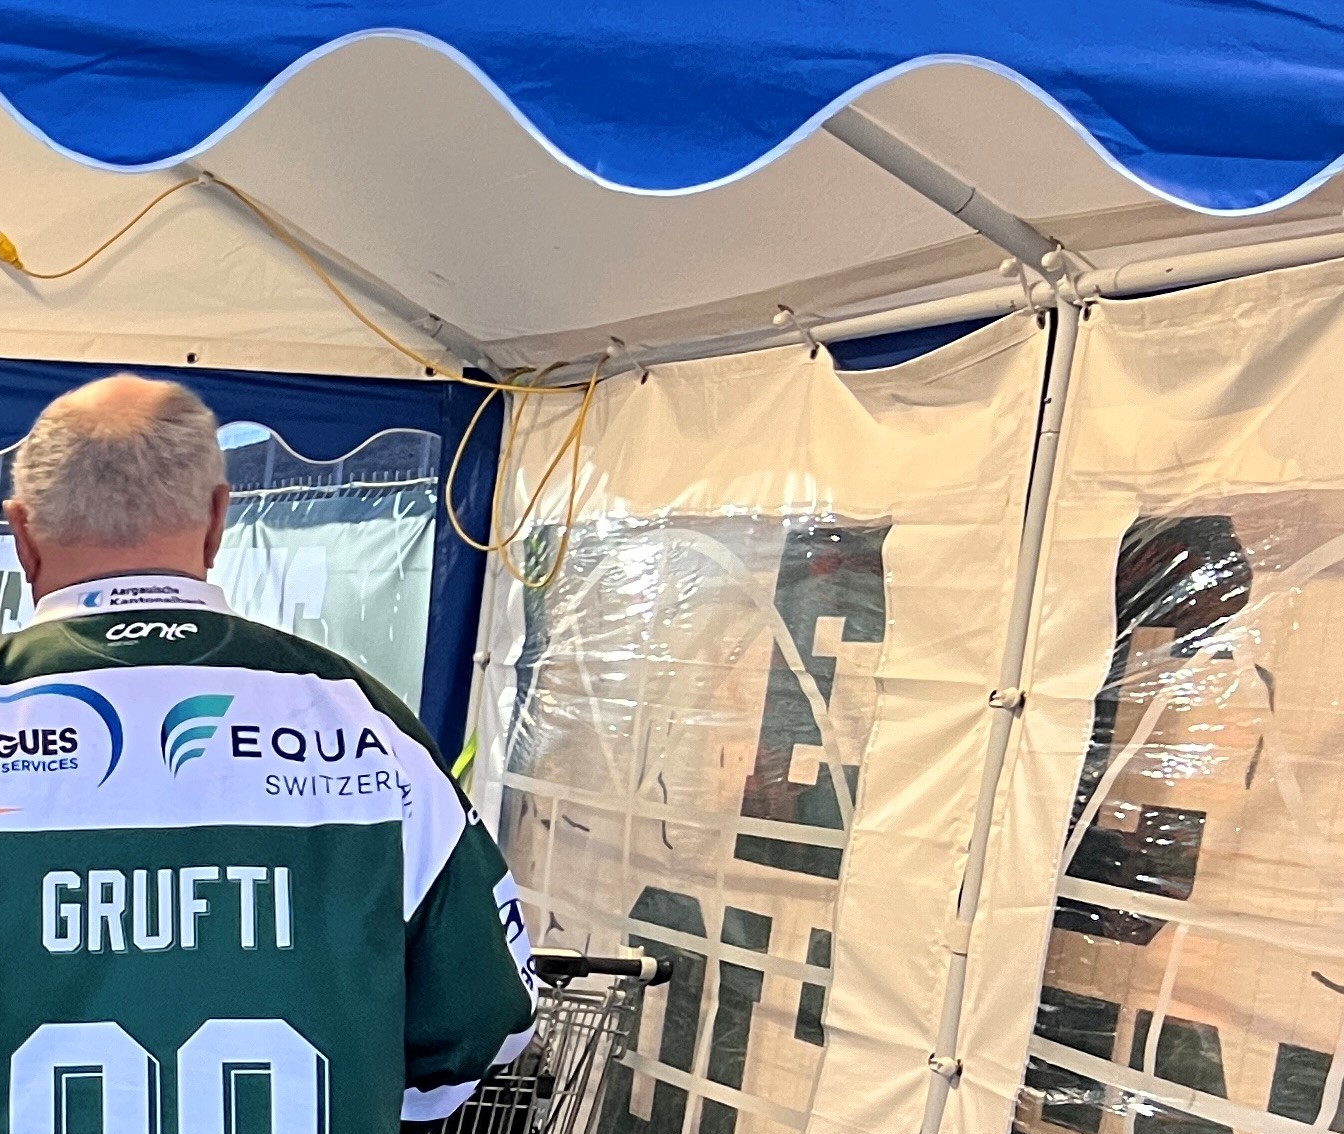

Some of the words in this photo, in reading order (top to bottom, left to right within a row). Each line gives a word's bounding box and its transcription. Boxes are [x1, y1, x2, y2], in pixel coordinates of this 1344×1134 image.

[231, 725, 395, 763] EQUA
[1, 757, 79, 774] SERVICES
[41, 865, 294, 954] GRUFTI
